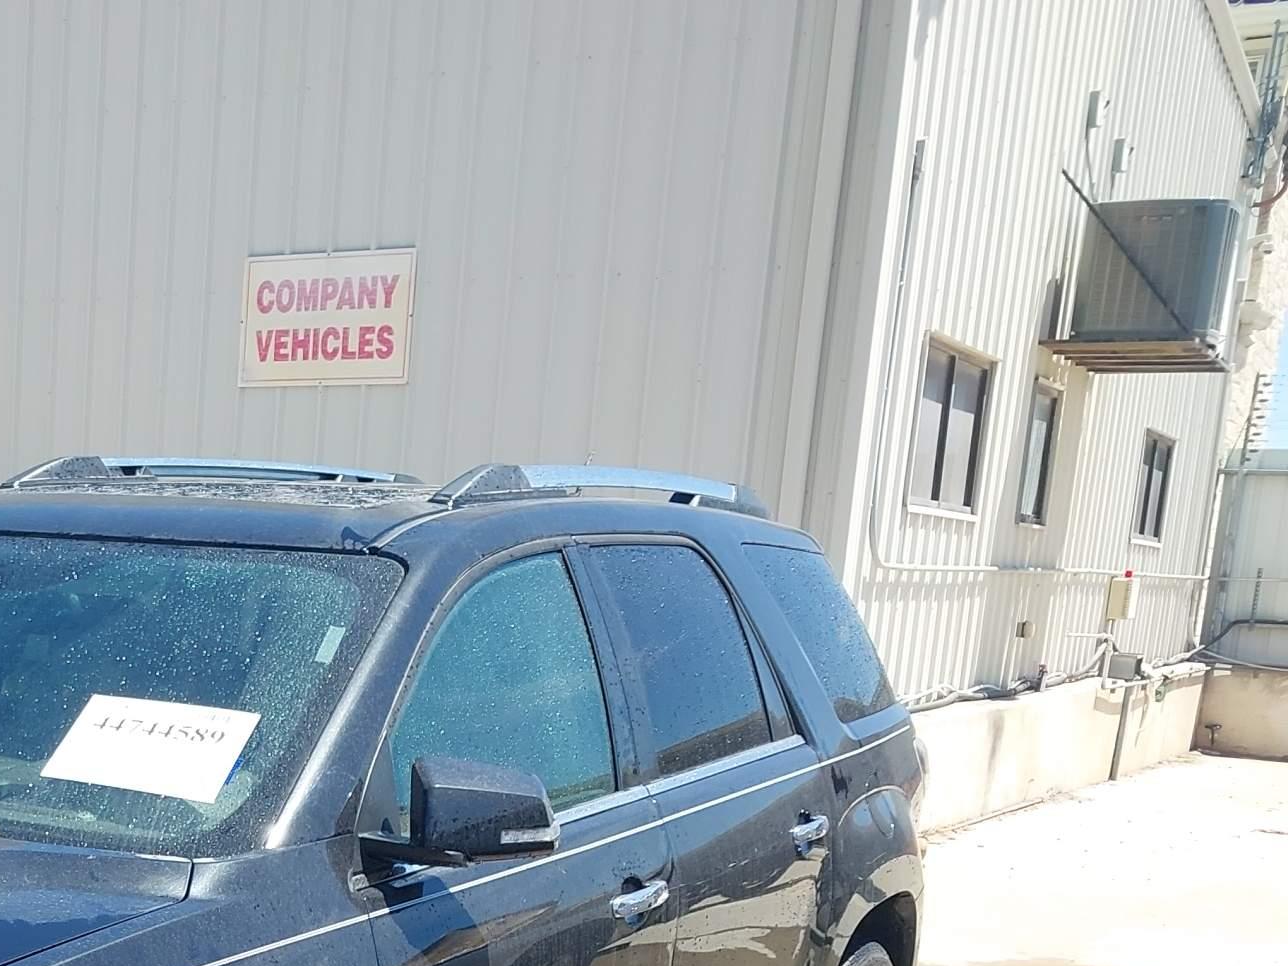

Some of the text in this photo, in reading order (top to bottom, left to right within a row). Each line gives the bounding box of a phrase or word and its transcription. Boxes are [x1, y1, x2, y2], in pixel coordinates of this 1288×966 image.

[257, 274, 400, 314] COMPANY
[256, 325, 394, 362] VEHICLES
[93, 716, 226, 744] 44744589
